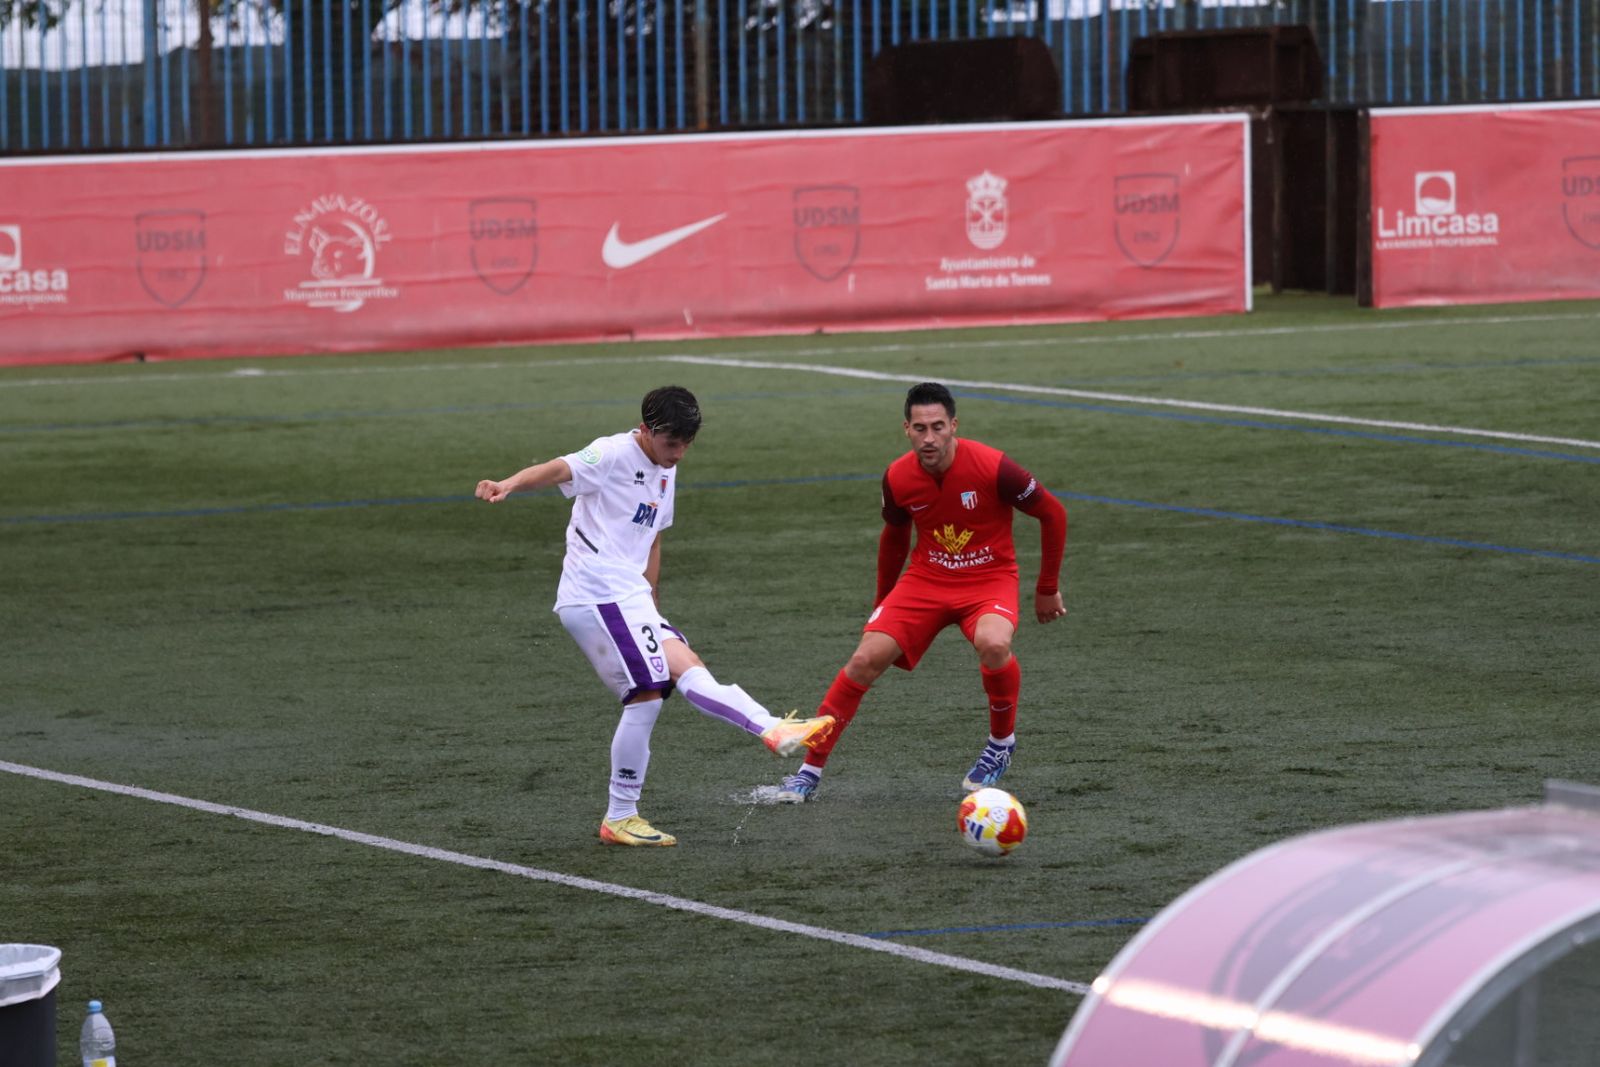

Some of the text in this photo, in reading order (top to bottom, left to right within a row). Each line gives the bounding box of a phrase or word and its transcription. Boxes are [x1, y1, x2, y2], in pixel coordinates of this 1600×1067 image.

[1114, 192, 1180, 215] UDSM
[792, 206, 859, 228] UDSM
[1378, 206, 1499, 238] Limcasa
[136, 229, 206, 252] UDSM
[469, 217, 537, 241] UDSM
[940, 255, 1035, 273] Ayuntamiento de
[925, 273, 1051, 290] Santa Marta de Tormes
[641, 625, 658, 653] 3
